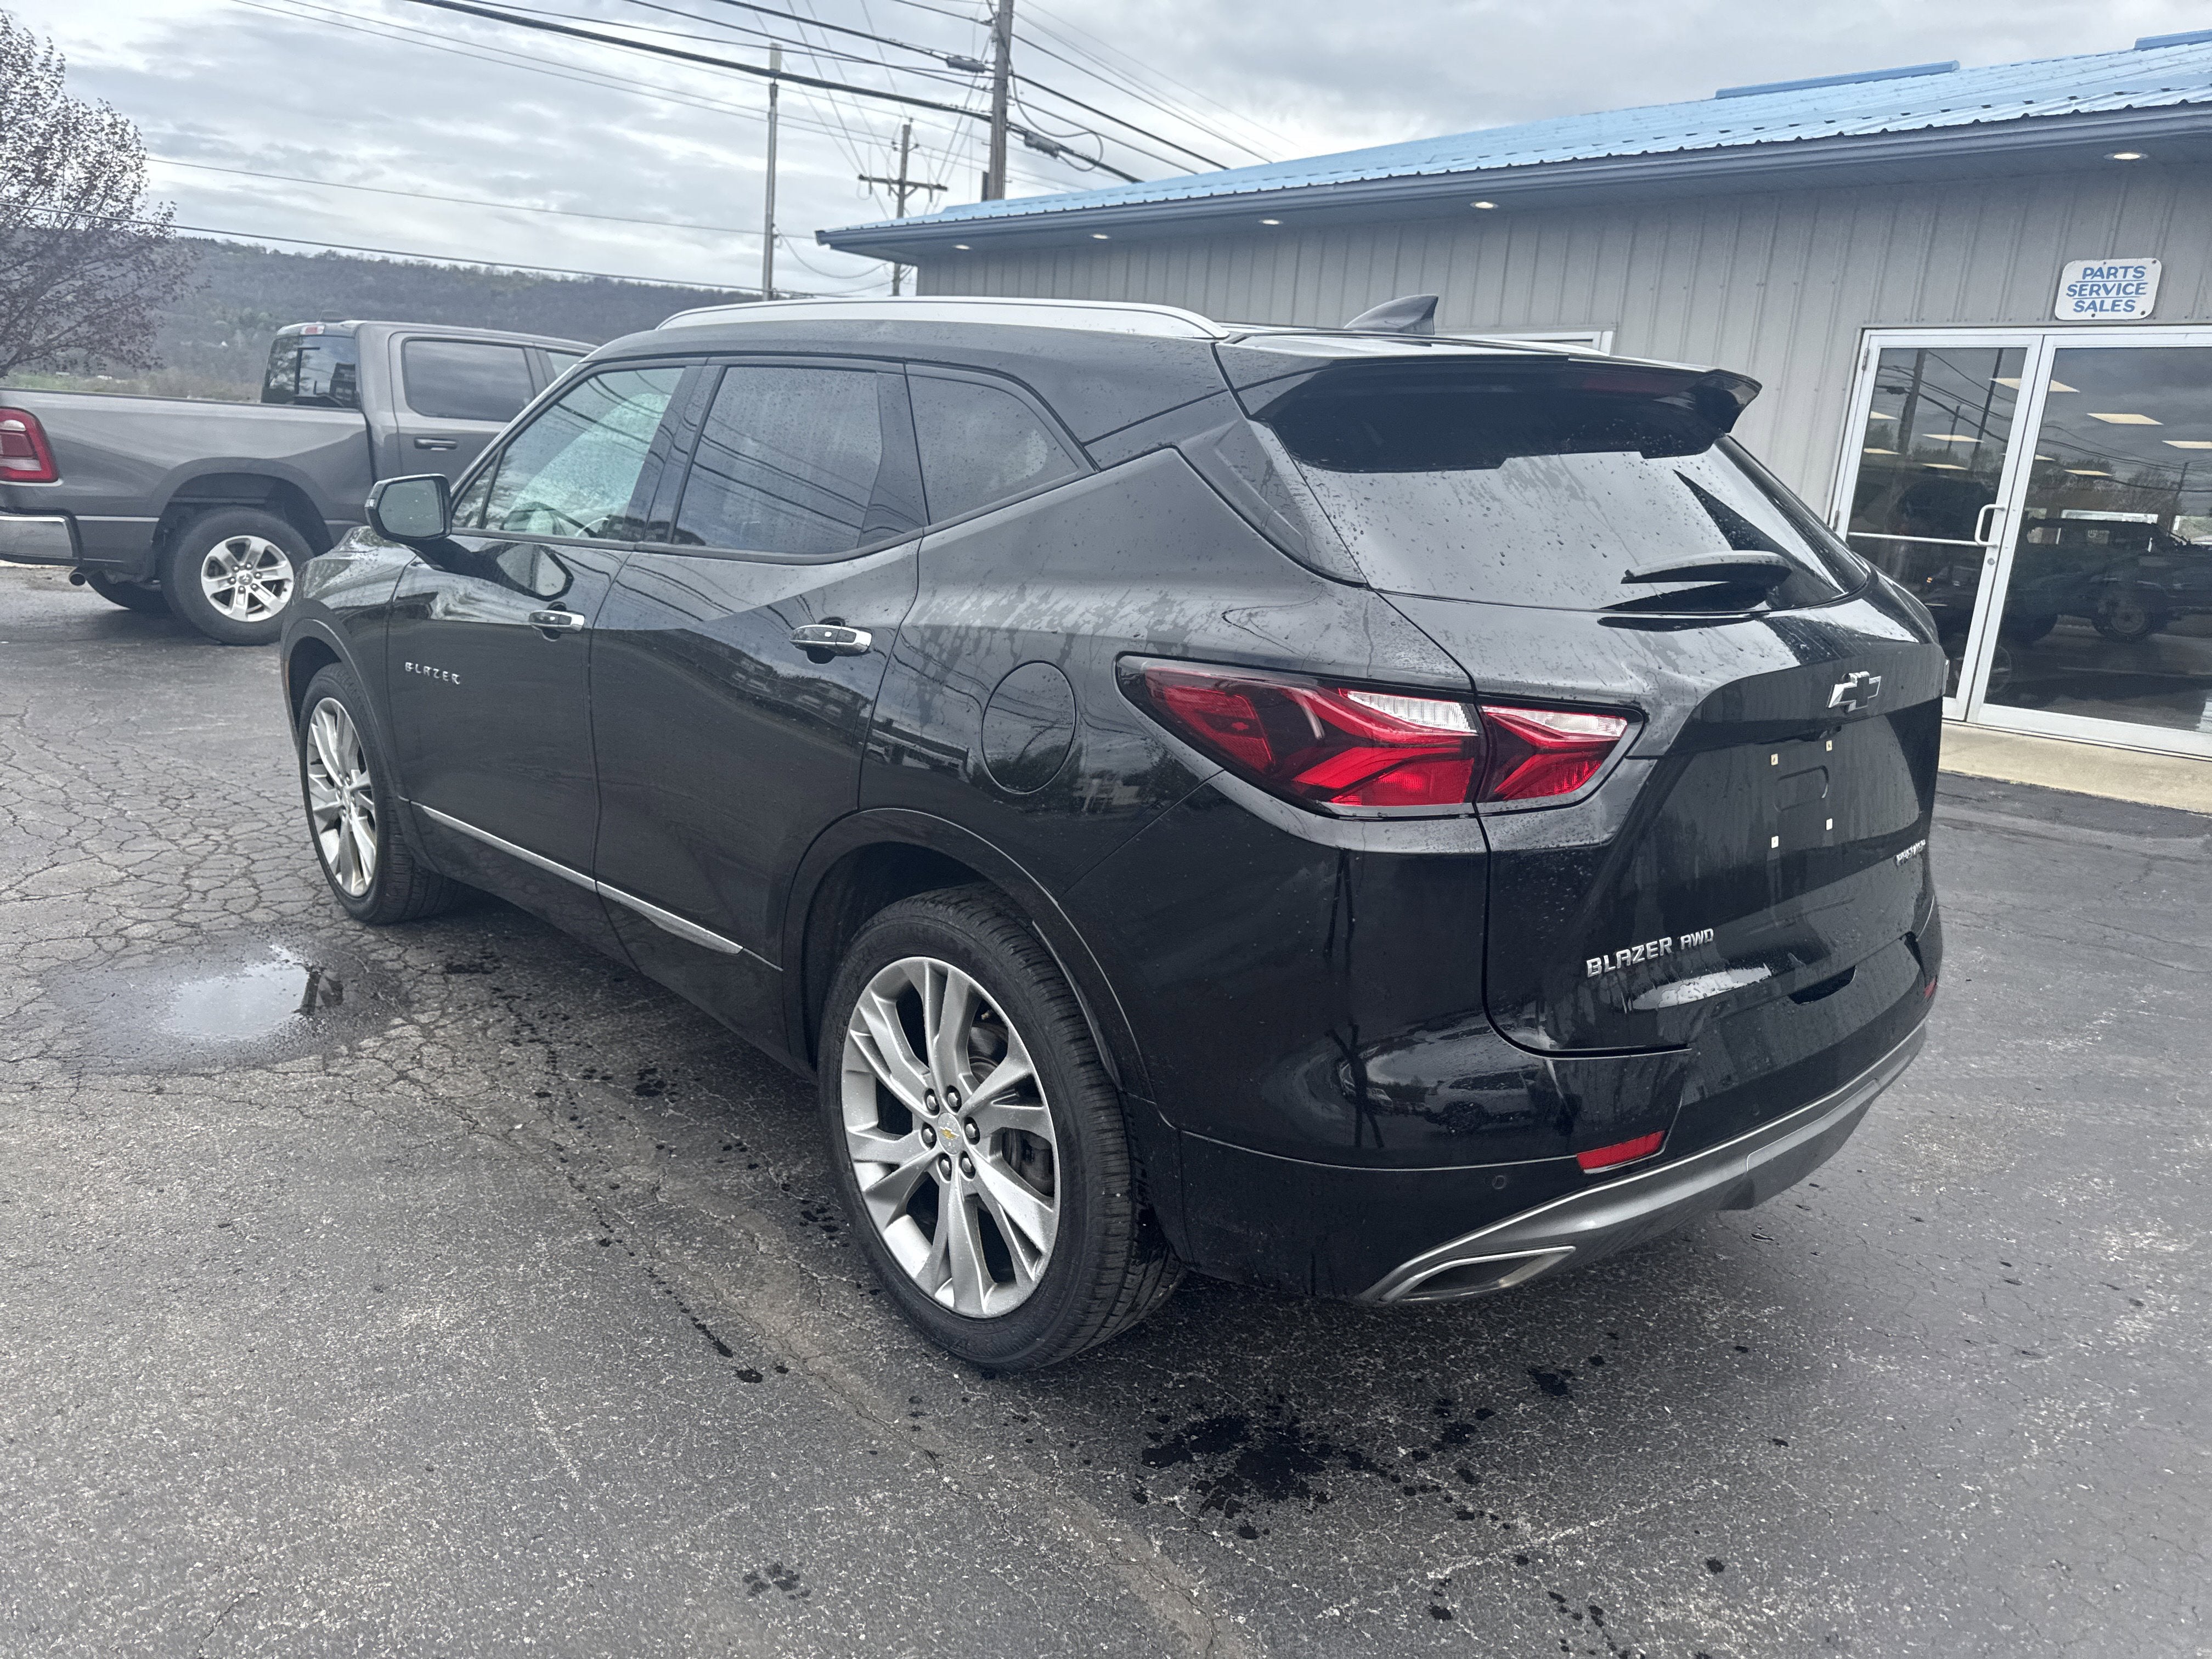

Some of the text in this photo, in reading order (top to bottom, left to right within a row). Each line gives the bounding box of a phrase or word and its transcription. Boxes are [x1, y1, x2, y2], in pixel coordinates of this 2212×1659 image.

[2082, 266, 2146, 279] PARTS
[2066, 282, 2148, 297] SERVICE
[2073, 299, 2136, 312] SALES
[405, 662, 460, 685] BLAZER
[1586, 928, 1714, 978] BLAZER AWD
